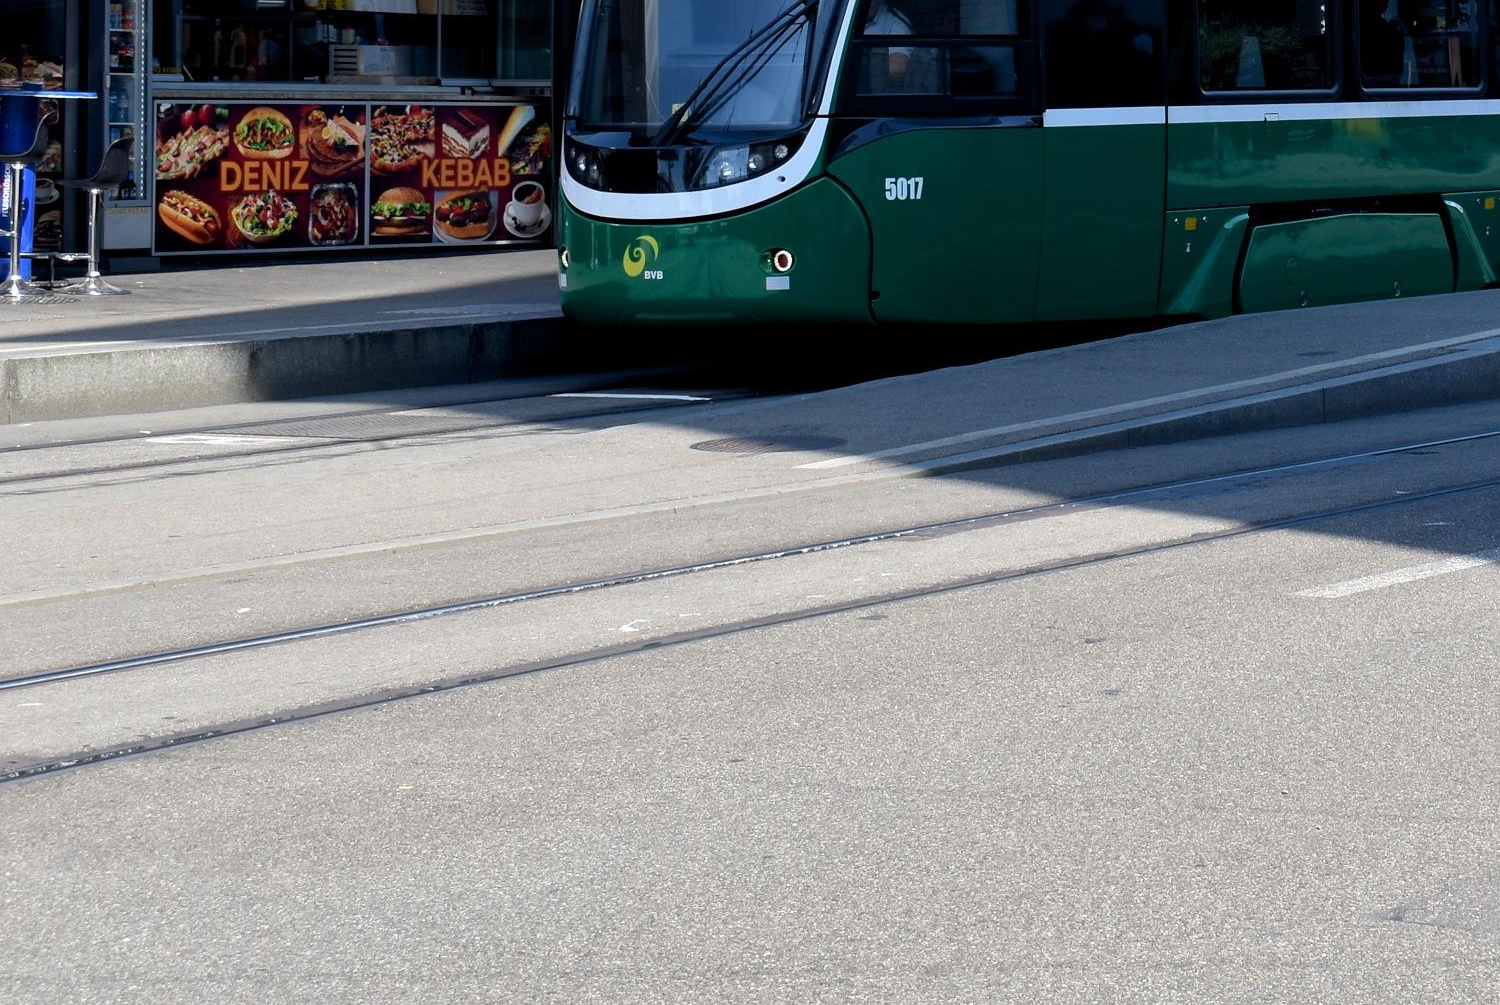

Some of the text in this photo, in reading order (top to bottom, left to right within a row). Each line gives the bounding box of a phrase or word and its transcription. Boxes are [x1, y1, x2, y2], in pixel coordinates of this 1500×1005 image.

[220, 158, 511, 191] DENIZ KEBAB
[885, 176, 924, 201] 5017
[644, 270, 664, 280] BVB
